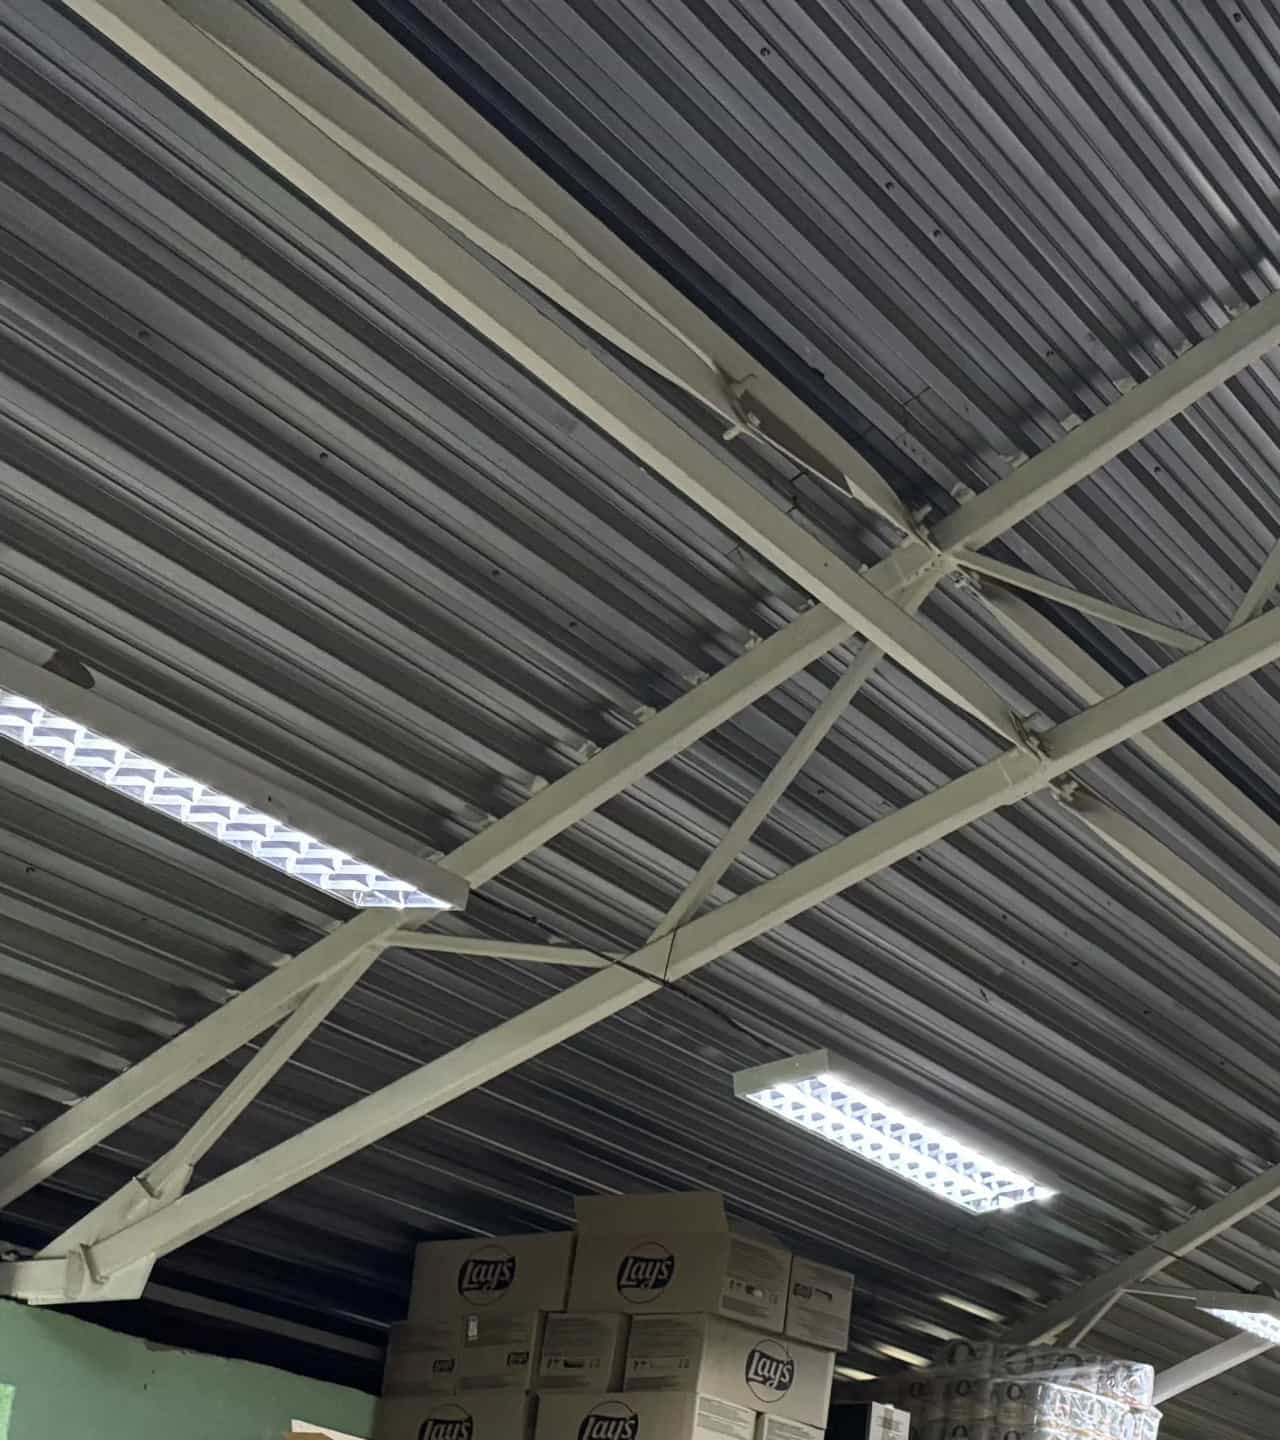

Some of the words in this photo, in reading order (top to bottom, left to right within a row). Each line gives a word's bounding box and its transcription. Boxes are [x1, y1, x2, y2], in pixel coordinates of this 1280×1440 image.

[460, 1255, 515, 1293] Lay's
[619, 1254, 675, 1291] Lay's
[748, 1349, 794, 1391] Lay's
